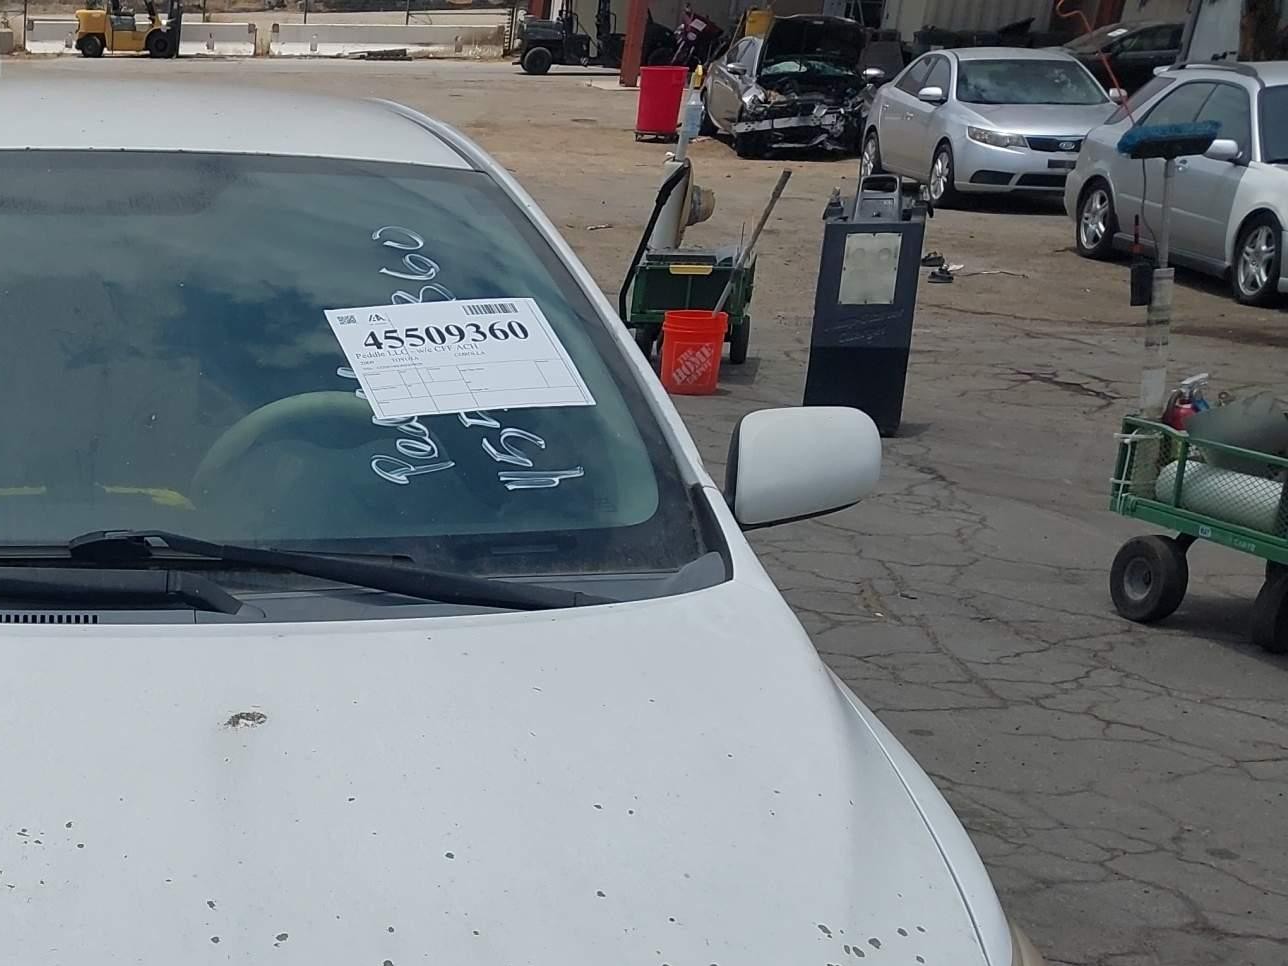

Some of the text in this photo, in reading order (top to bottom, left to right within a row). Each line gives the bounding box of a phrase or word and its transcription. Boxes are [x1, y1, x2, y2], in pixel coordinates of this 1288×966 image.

[364, 320, 528, 349] 45509360
[355, 351, 385, 360] Peddle
[388, 349, 408, 357] LLC
[672, 343, 713, 385] HOME
[686, 361, 712, 384] DEPOT
